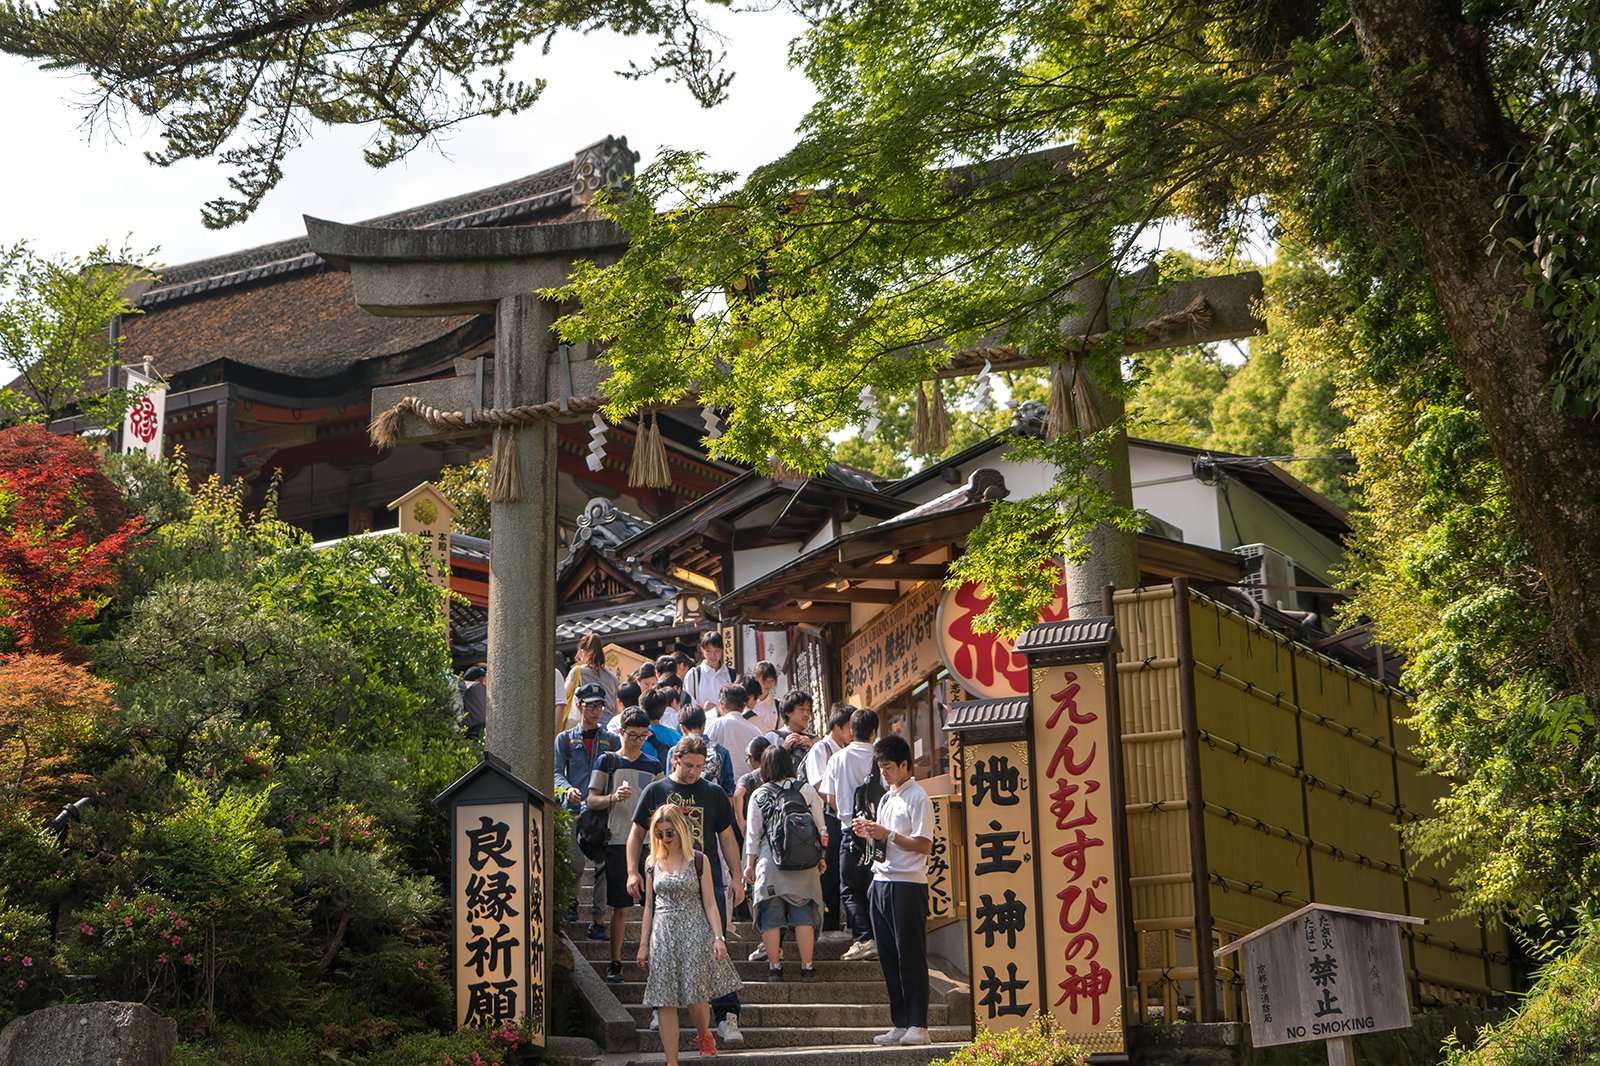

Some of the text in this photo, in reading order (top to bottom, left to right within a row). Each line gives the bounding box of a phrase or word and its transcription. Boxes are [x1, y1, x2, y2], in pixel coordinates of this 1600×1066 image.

[845, 642, 882, 697] 恋のお守り
[1045, 671, 1113, 1026] えんむすびの神
[970, 755, 1033, 1020] 地主神社
[464, 816, 520, 1029] 良縁祈願
[530, 818, 544, 1035] 良縁祈願
[1304, 916, 1318, 953] たばこ
[1319, 914, 1334, 950] たき火
[1256, 963, 1273, 1024] 京都市消防局
[1308, 953, 1343, 1018] 禁止
[1287, 1016, 1375, 1039] NO SMOKING
